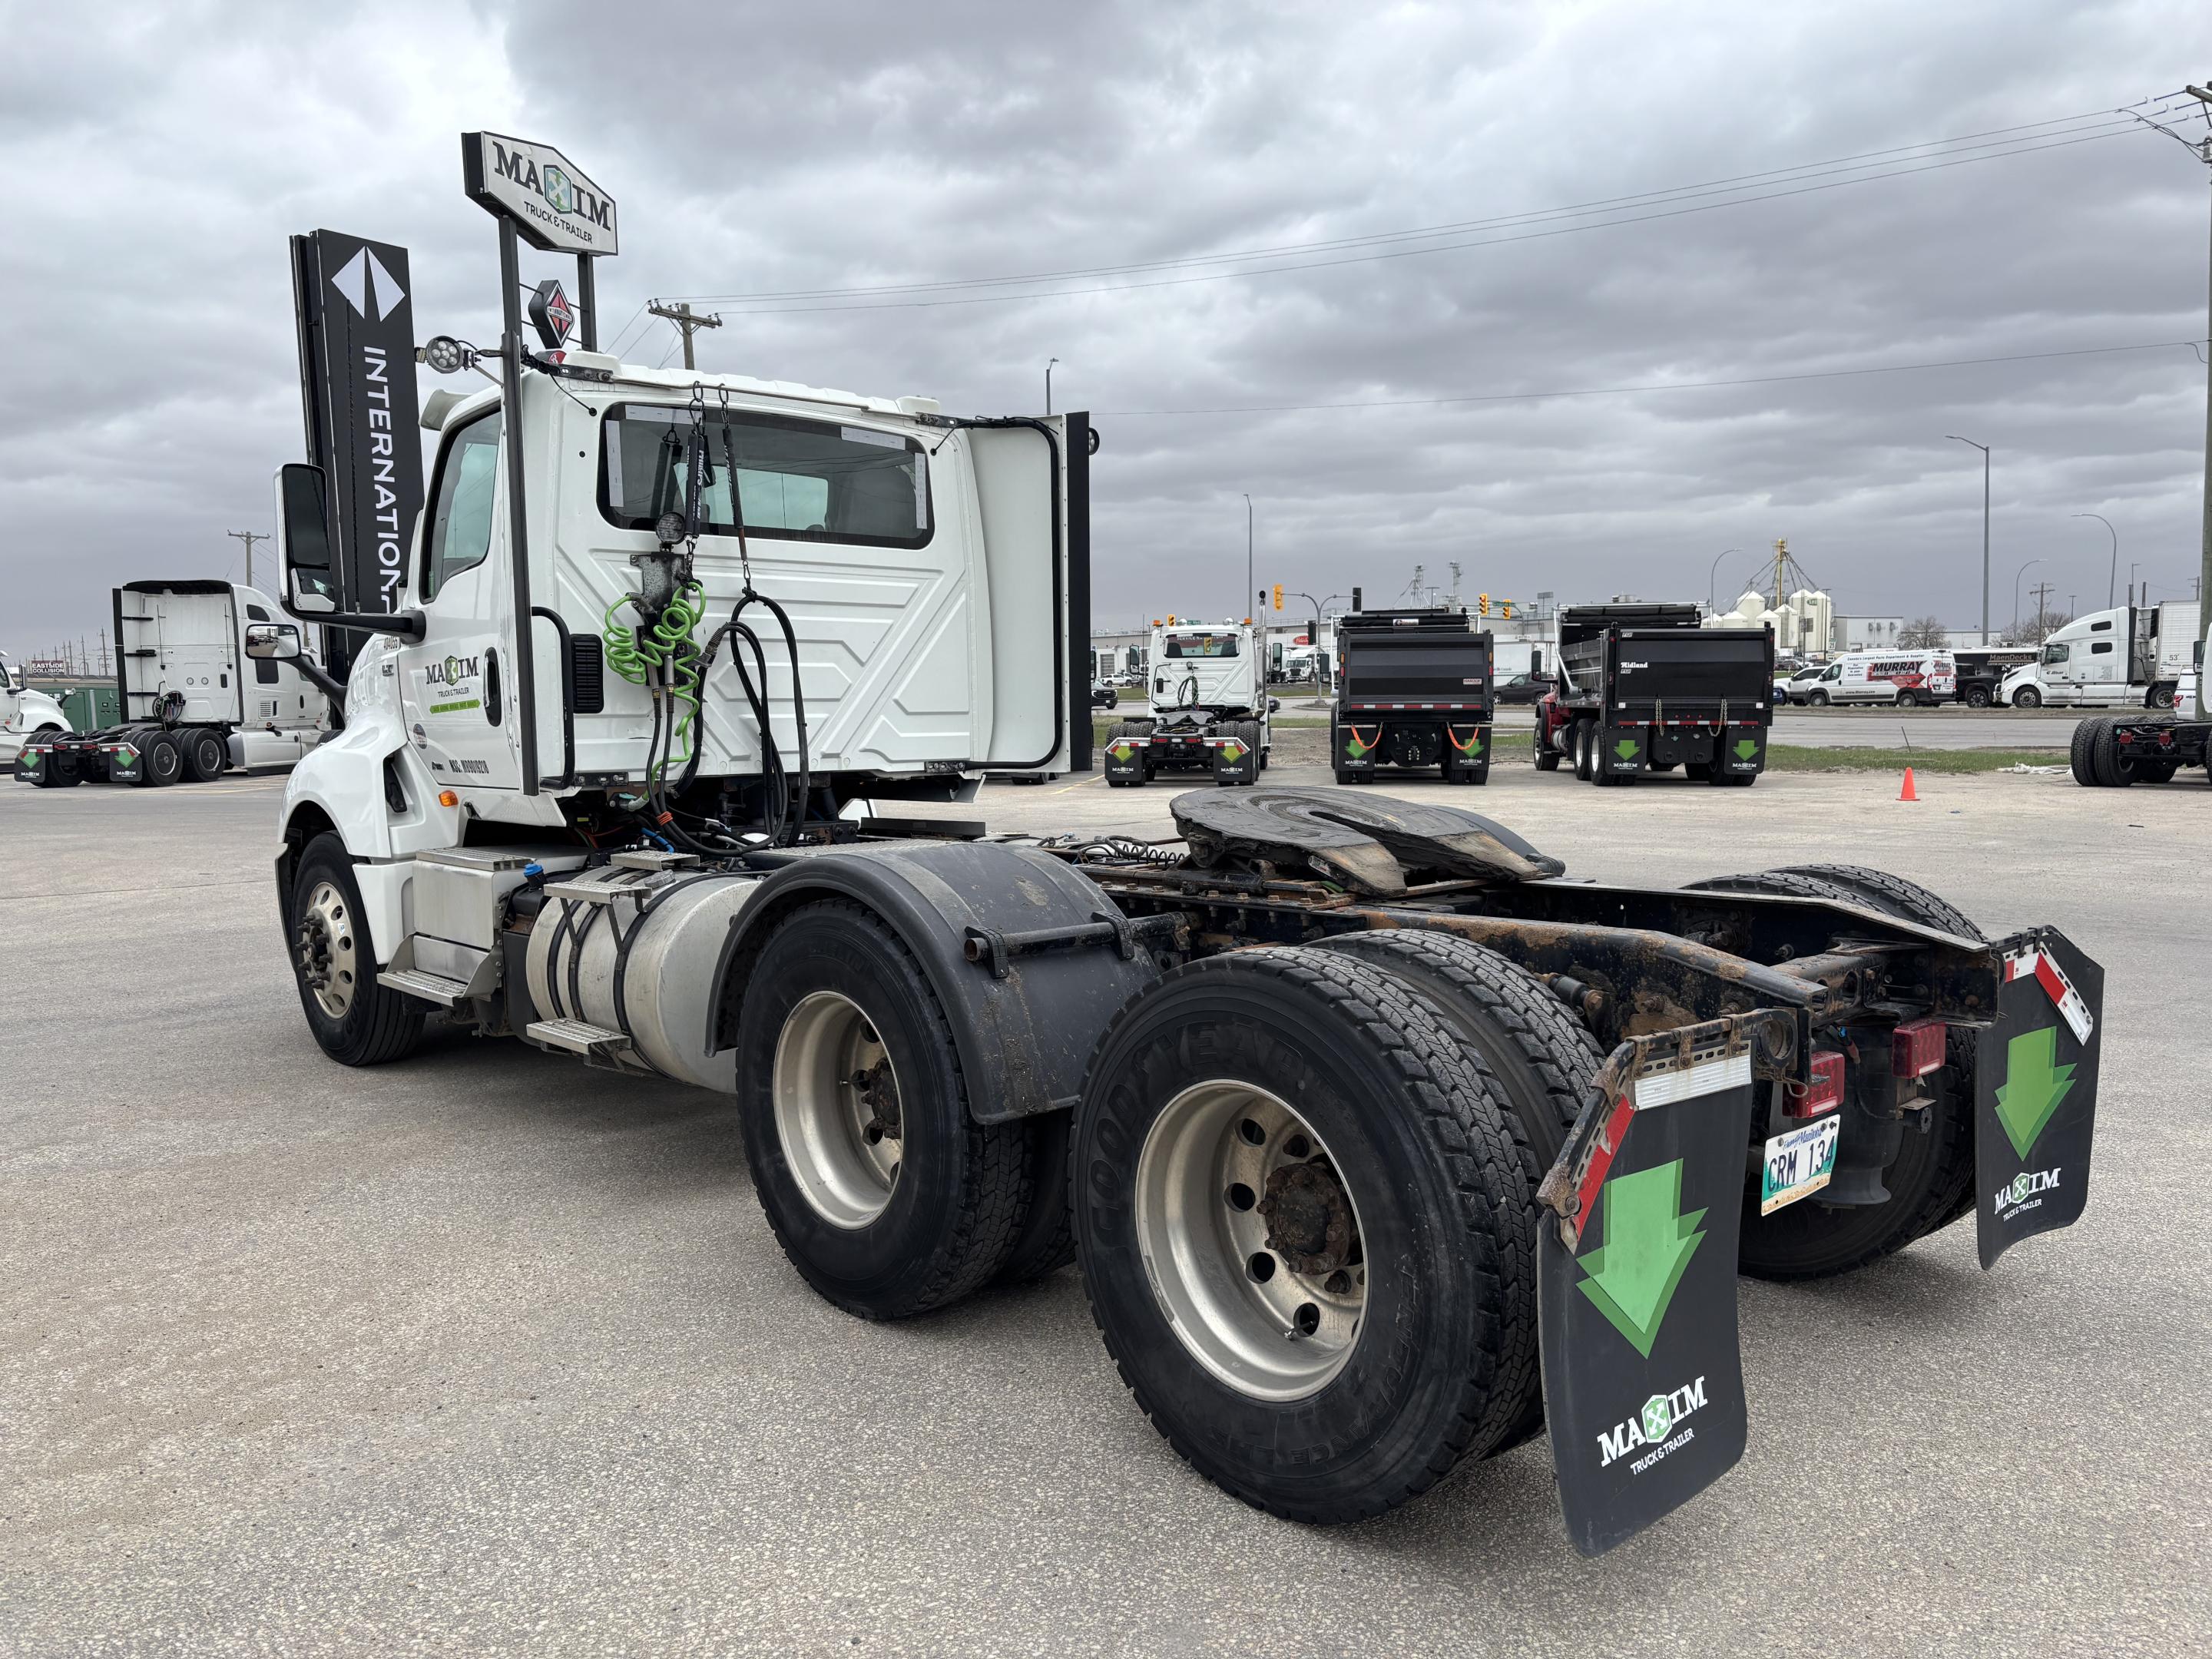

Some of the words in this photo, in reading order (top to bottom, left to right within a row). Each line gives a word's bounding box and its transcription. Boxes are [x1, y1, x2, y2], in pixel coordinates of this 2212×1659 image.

[492, 141, 611, 232] MAXIM
[524, 200, 553, 225] TRUCK
[554, 216, 560, 227] &
[560, 219, 592, 243] TRAILER
[363, 346, 402, 614] INTERNATION
[425, 655, 479, 686] MAXIM
[1873, 661, 1928, 674] MURRAY
[438, 690, 451, 698] TRUCK
[1089, 1018, 1304, 1250] GOODYEAR
[1768, 1149, 1798, 1192] CRM
[1809, 1135, 1835, 1177] 134
[1995, 1167, 2061, 1215] MAXIM
[2003, 1207, 2015, 1223] TRUCK
[2019, 1198, 2042, 1212] TRAILER
[1597, 1376, 1708, 1468] MAXIM
[1630, 1450, 1658, 1475] TRUCK
[1657, 1447, 1664, 1459] &
[1663, 1427, 1694, 1456] TRAILER
